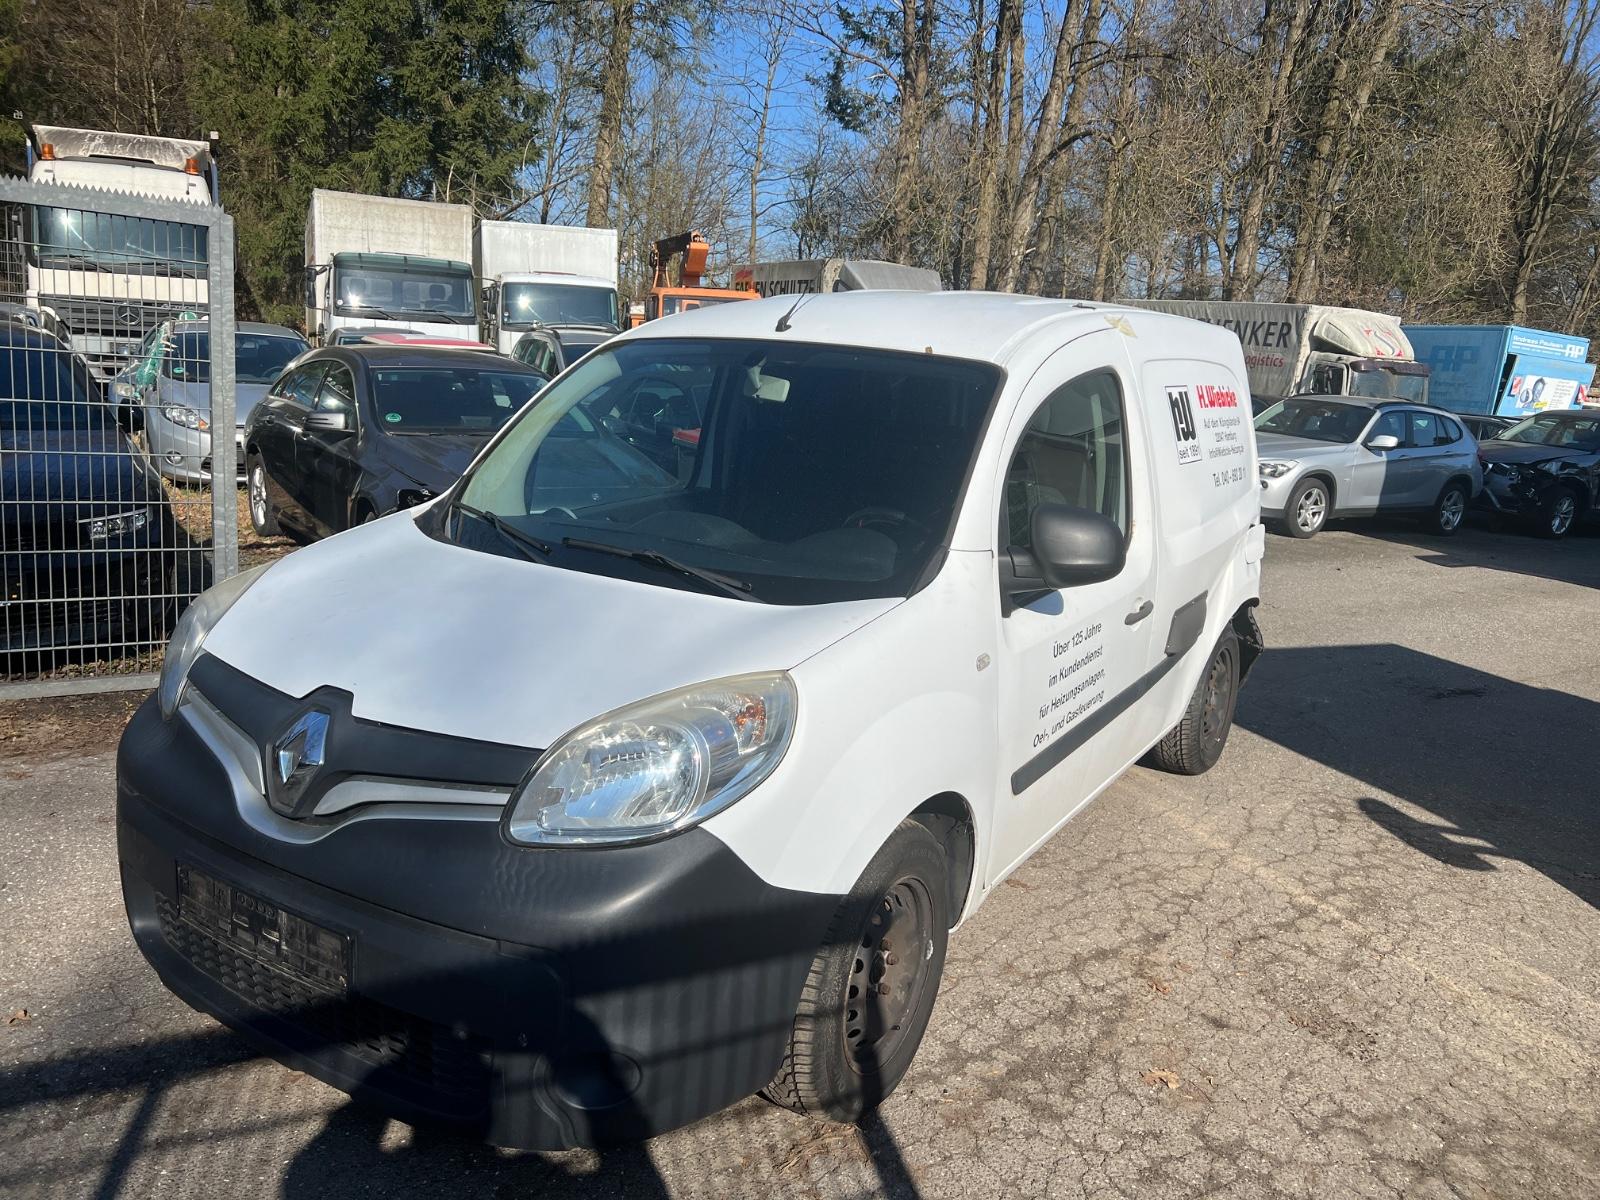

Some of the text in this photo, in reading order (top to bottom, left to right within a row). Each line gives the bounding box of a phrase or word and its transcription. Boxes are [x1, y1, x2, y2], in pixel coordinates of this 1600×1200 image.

[1245, 353, 1285, 369] ogistics
[1053, 623, 1102, 659] Über 125 Jahre
[1048, 645, 1103, 688] im Kundendienst
[1039, 704, 1049, 720] für
[1051, 715, 1065, 735] und
[1065, 690, 1104, 724] Gasfeuerung
